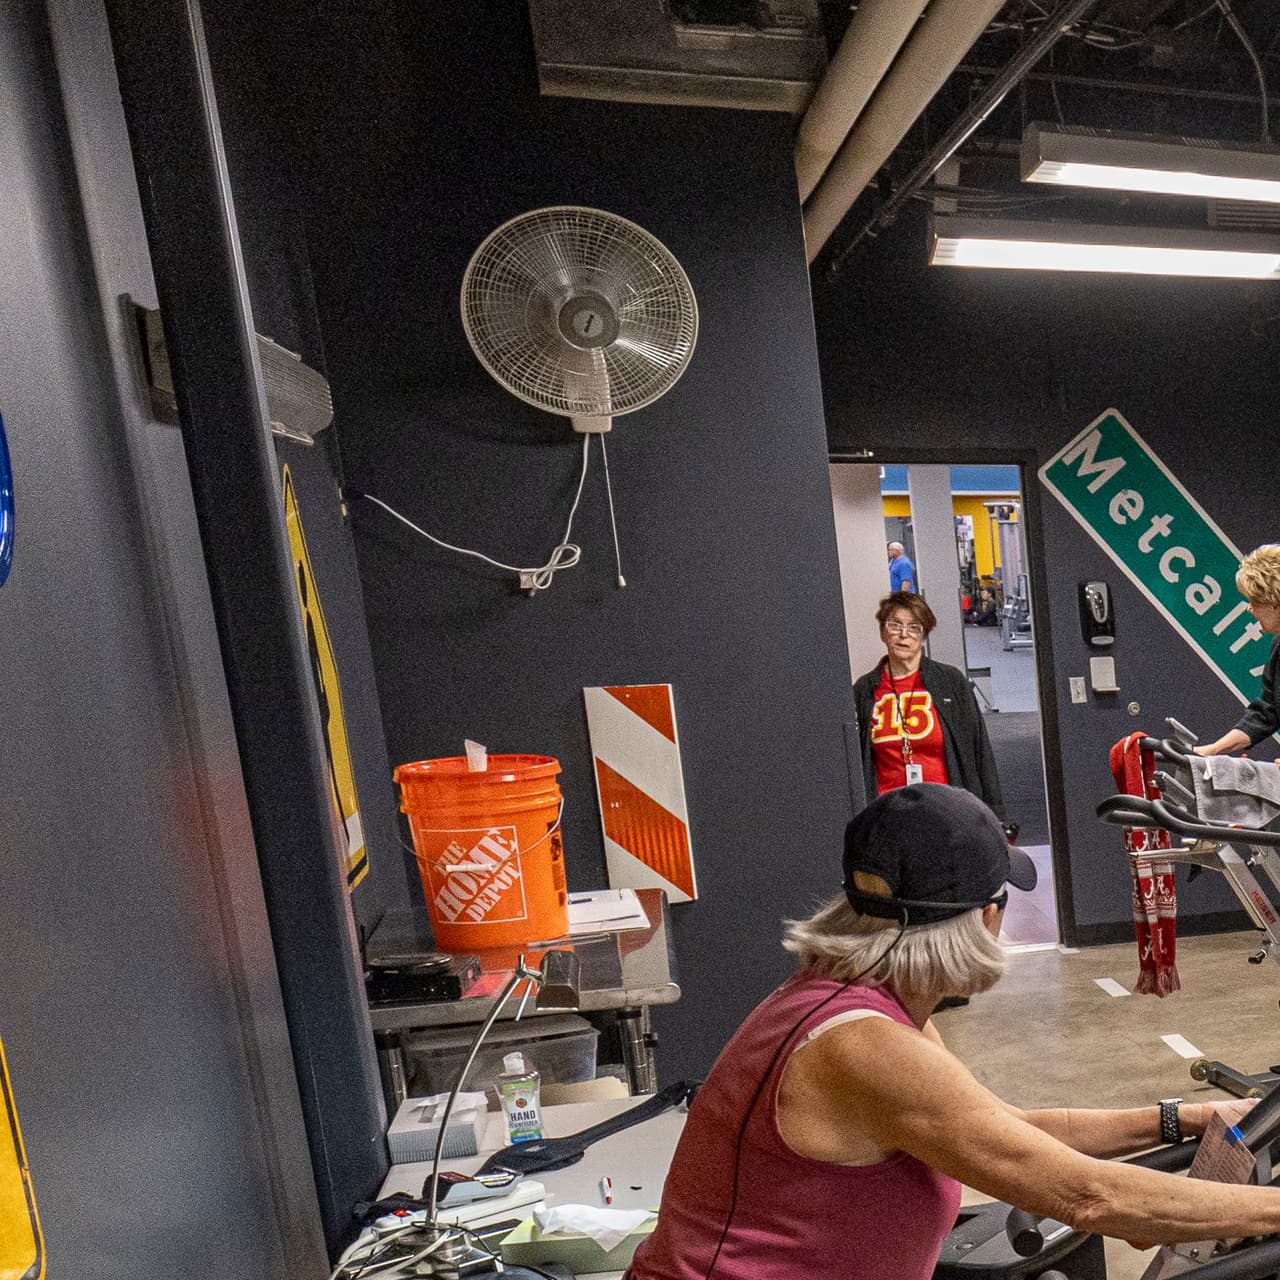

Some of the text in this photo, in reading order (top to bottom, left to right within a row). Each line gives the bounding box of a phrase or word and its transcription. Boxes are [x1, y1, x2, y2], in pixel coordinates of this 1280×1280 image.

[871, 691, 934, 744] 15
[434, 829, 518, 922] HOME
[465, 862, 521, 922] DEPOT
[510, 1110, 536, 1121] HAND
